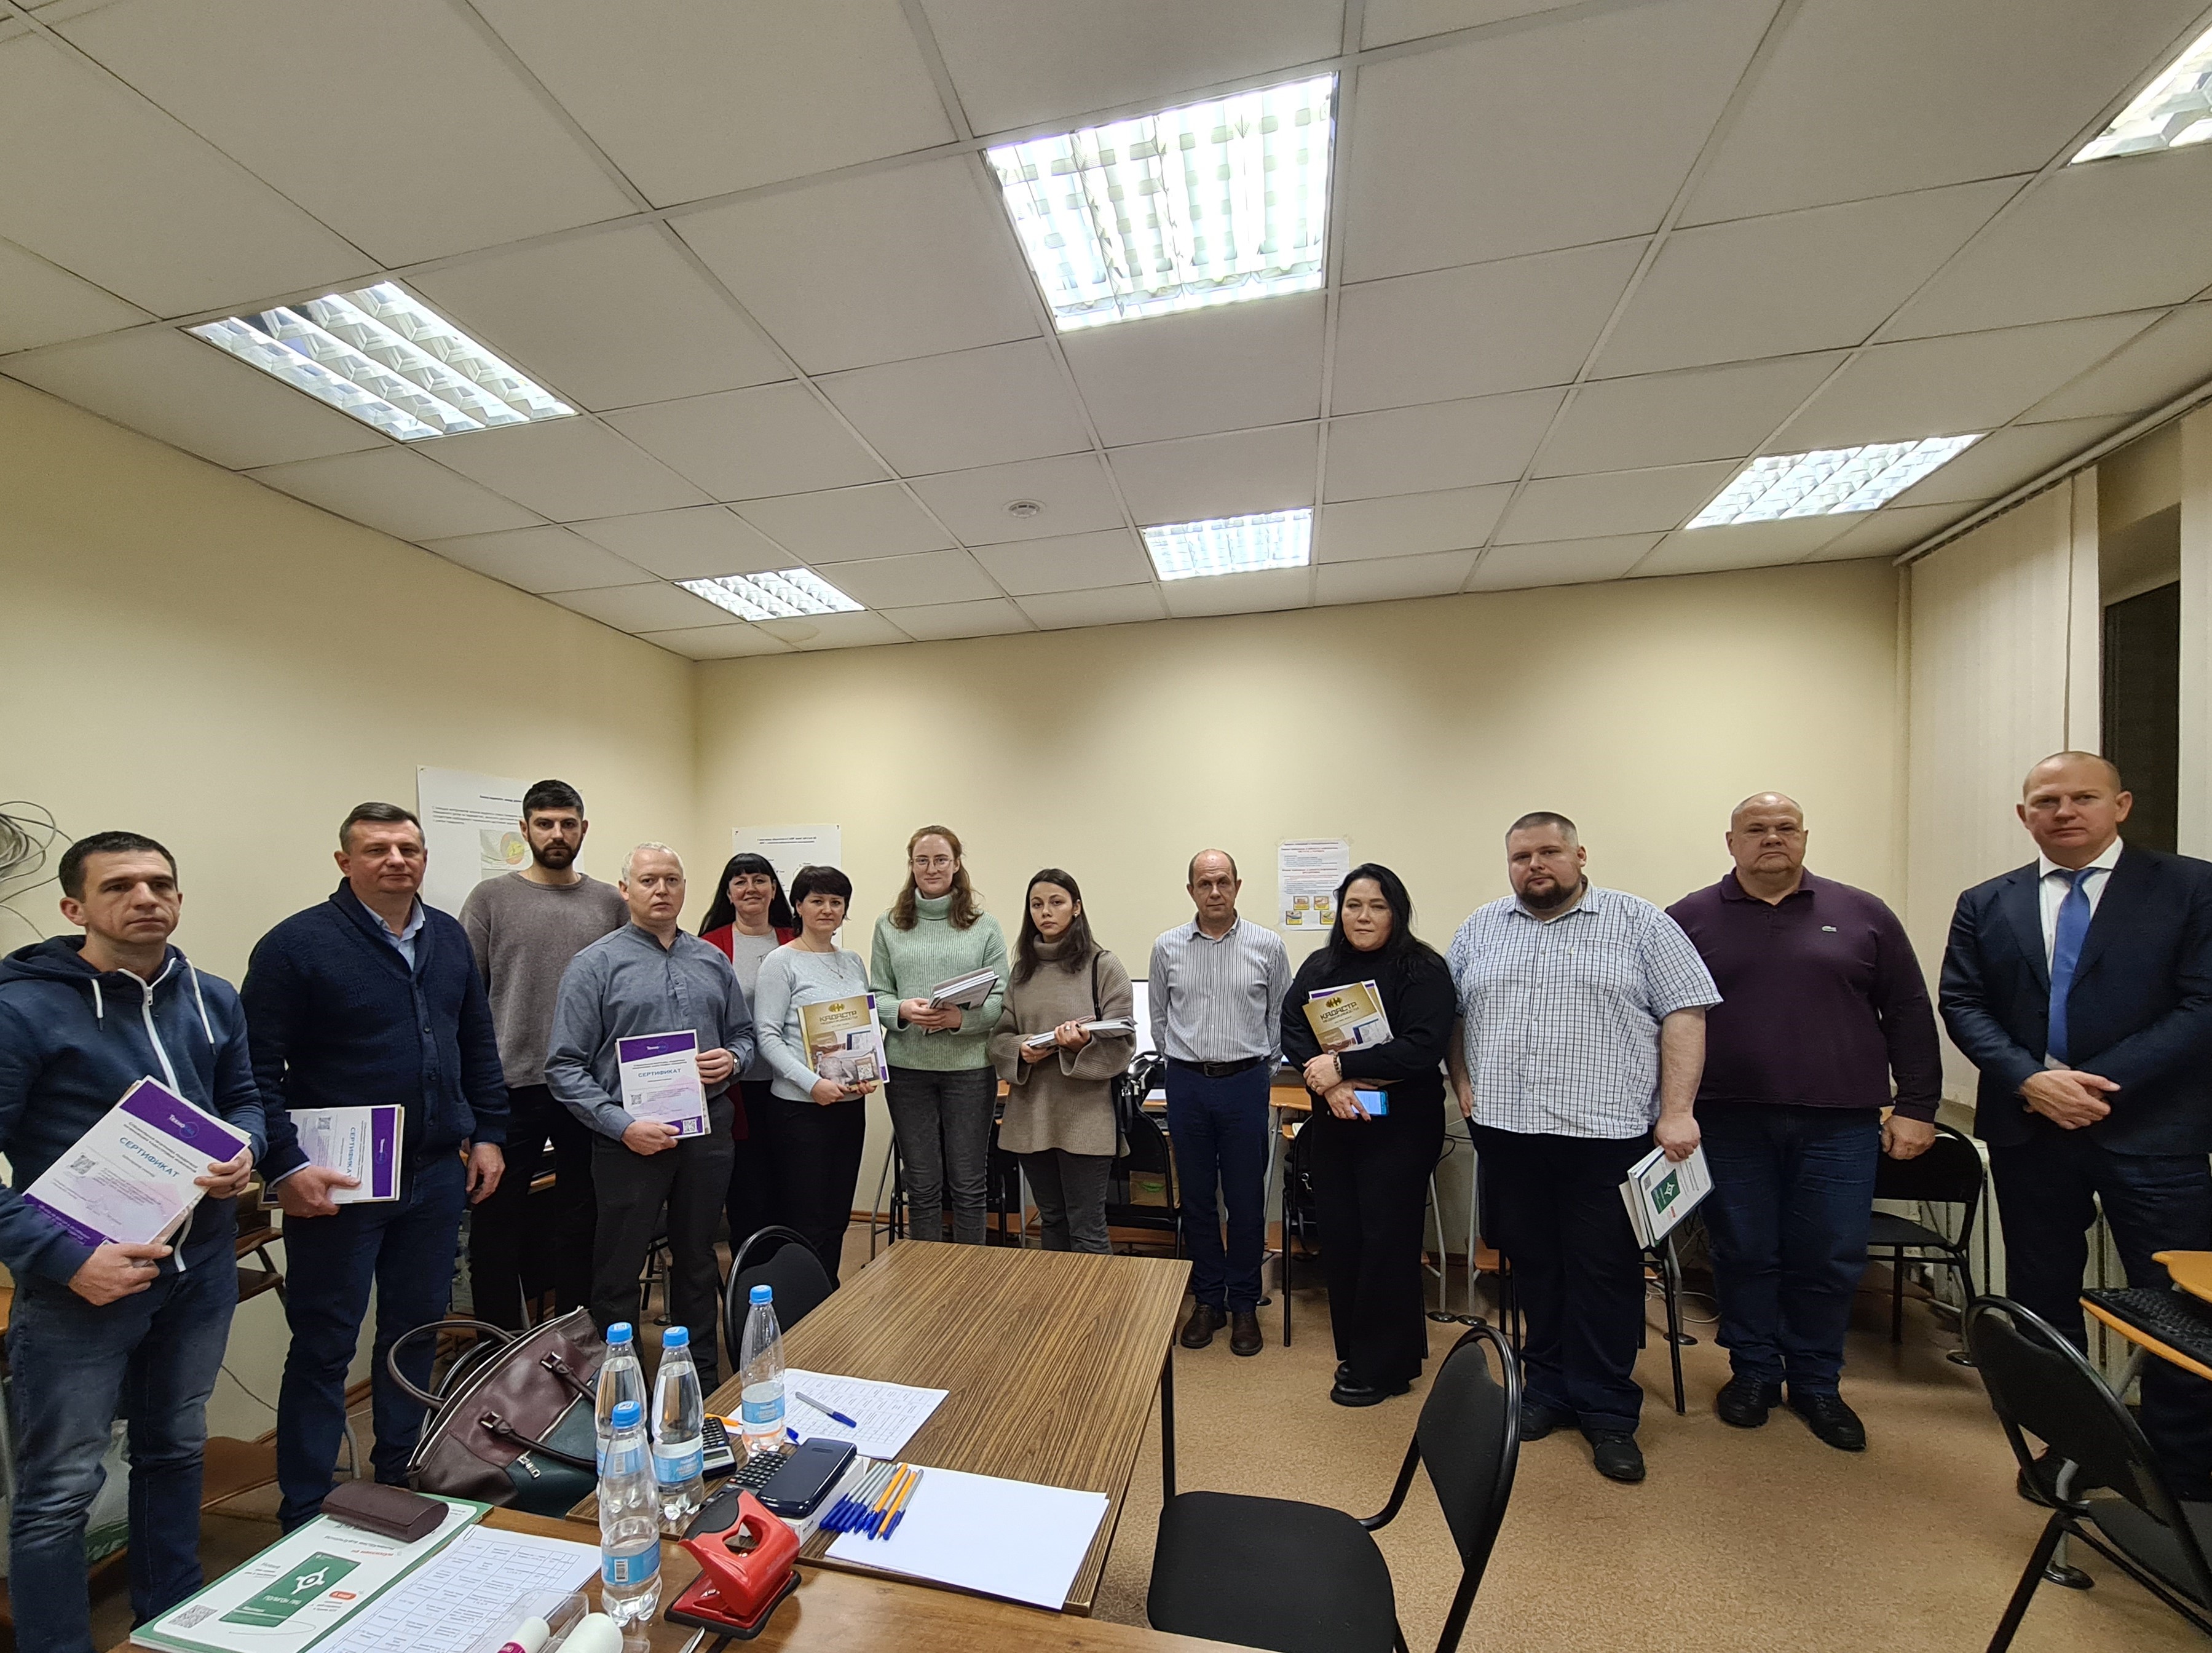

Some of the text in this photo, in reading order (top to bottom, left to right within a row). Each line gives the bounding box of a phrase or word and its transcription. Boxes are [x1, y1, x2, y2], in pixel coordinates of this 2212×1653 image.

[820, 1010, 857, 1022] КАДАСТР
[1320, 1002, 1357, 1020] КАДАСТР
[638, 1068, 681, 1077] СЕРТИФИКАТ
[119, 1137, 180, 1178] СЕРТИФИКАТ
